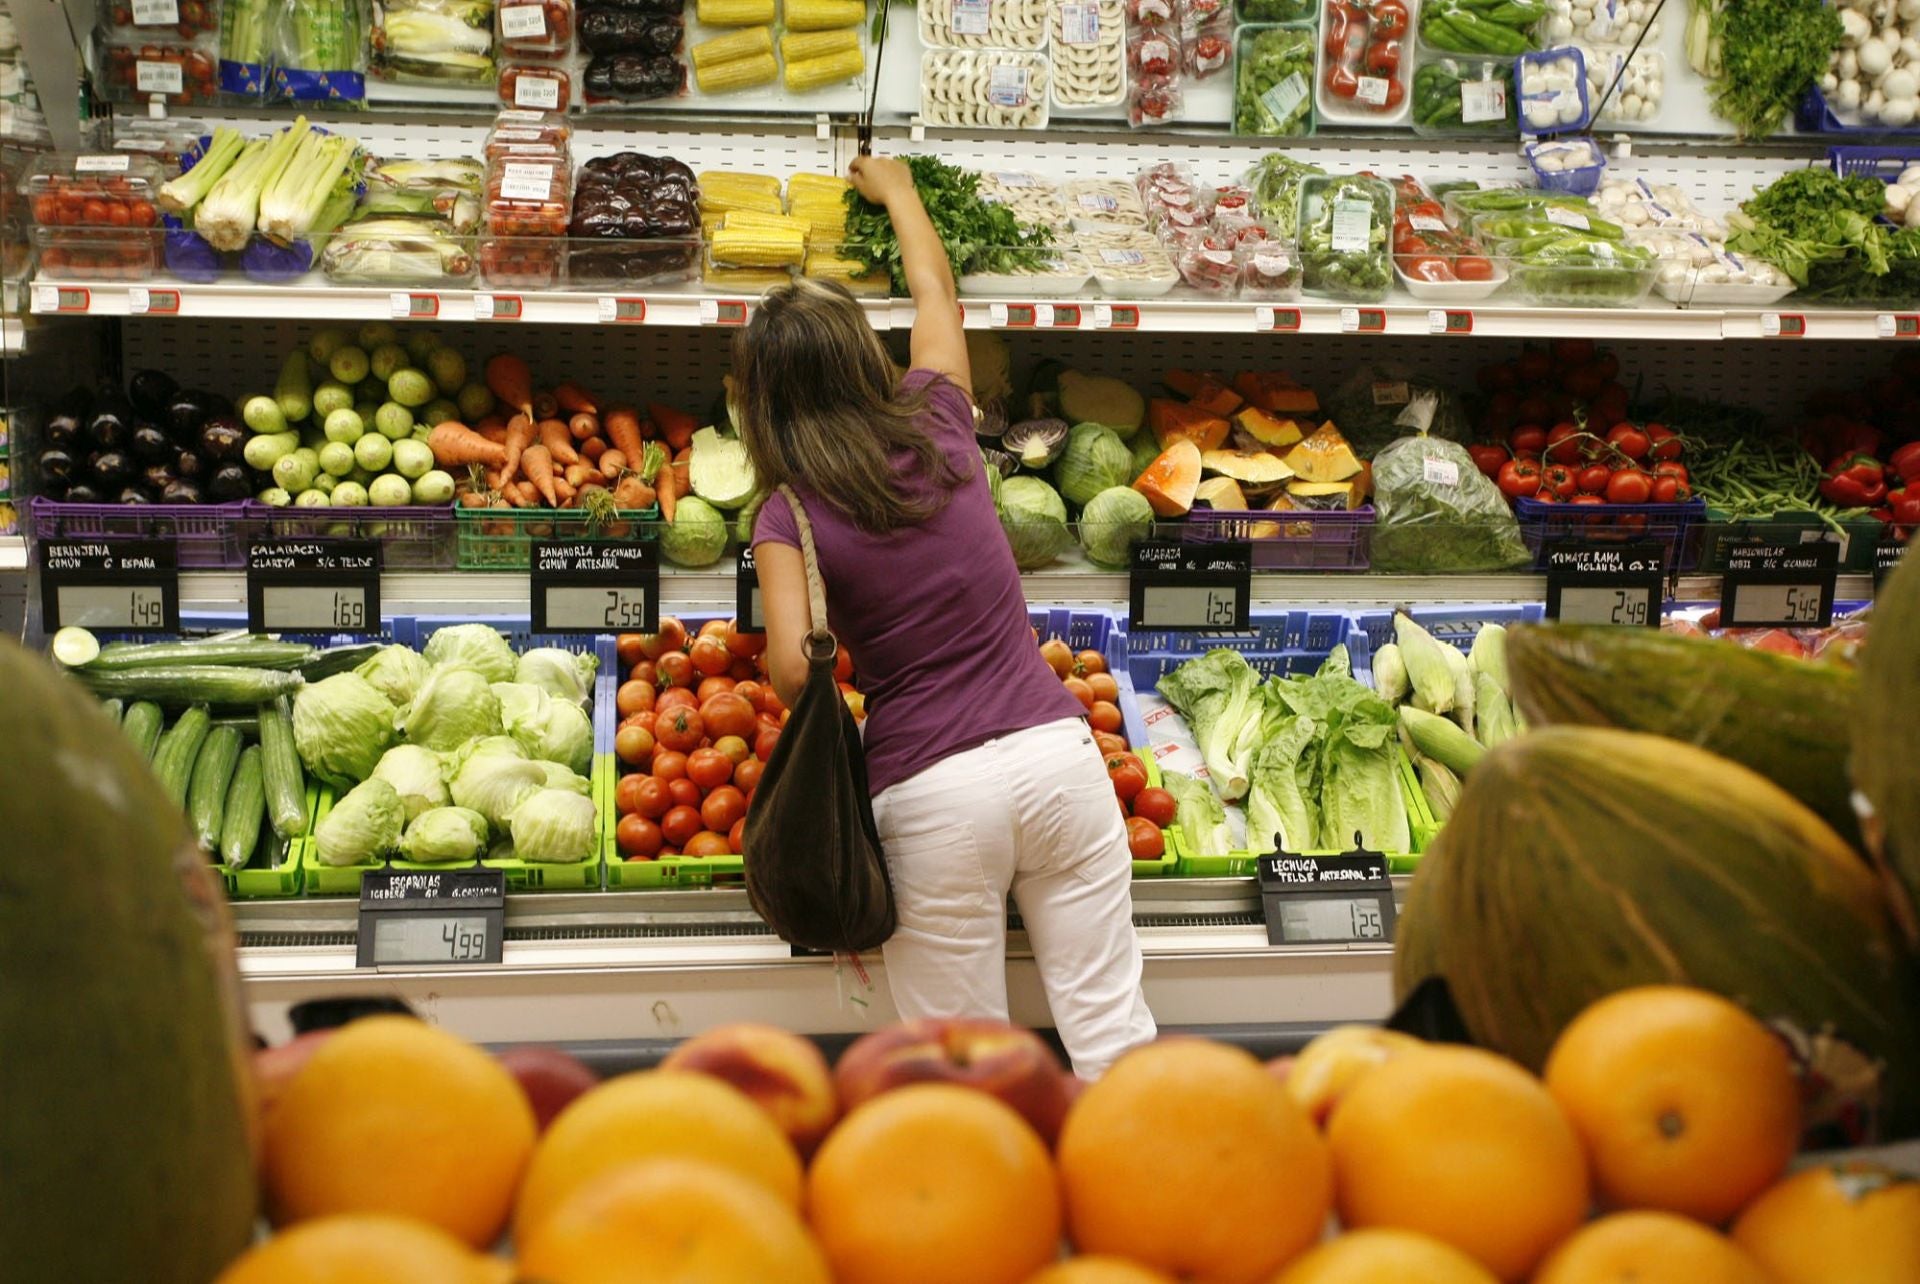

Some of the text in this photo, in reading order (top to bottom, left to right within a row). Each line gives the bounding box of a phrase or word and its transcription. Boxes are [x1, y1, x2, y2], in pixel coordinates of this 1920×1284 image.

[49, 545, 110, 557] BERENJENA
[539, 546, 593, 558] ZANAHORIA
[1139, 547, 1181, 561] CALABAZA
[1551, 551, 1620, 563] TOMATE RAMA
[1732, 547, 1785, 557] HABICHUELAS
[1877, 547, 1909, 557] PIMIENT
[121, 557, 156, 569] ESPAÑA
[252, 558, 295, 568] CLARITA
[575, 558, 620, 569] ARTESANAL
[1577, 562, 1624, 572] HOLANDA
[131, 591, 160, 626] 1.49
[333, 591, 363, 627] 1.69
[605, 591, 642, 626] 2.59
[1206, 591, 1233, 625] 1.25
[1611, 590, 1646, 624] 2.49
[1784, 588, 1818, 620] 5.45
[1271, 859, 1318, 873] LECHUGA
[389, 875, 441, 890] ESCAROLAS
[1279, 872, 1315, 882] TELDE
[1320, 869, 1366, 881] ARTESANAL
[1350, 903, 1381, 938] 1.25
[442, 922, 484, 960] 4.99
